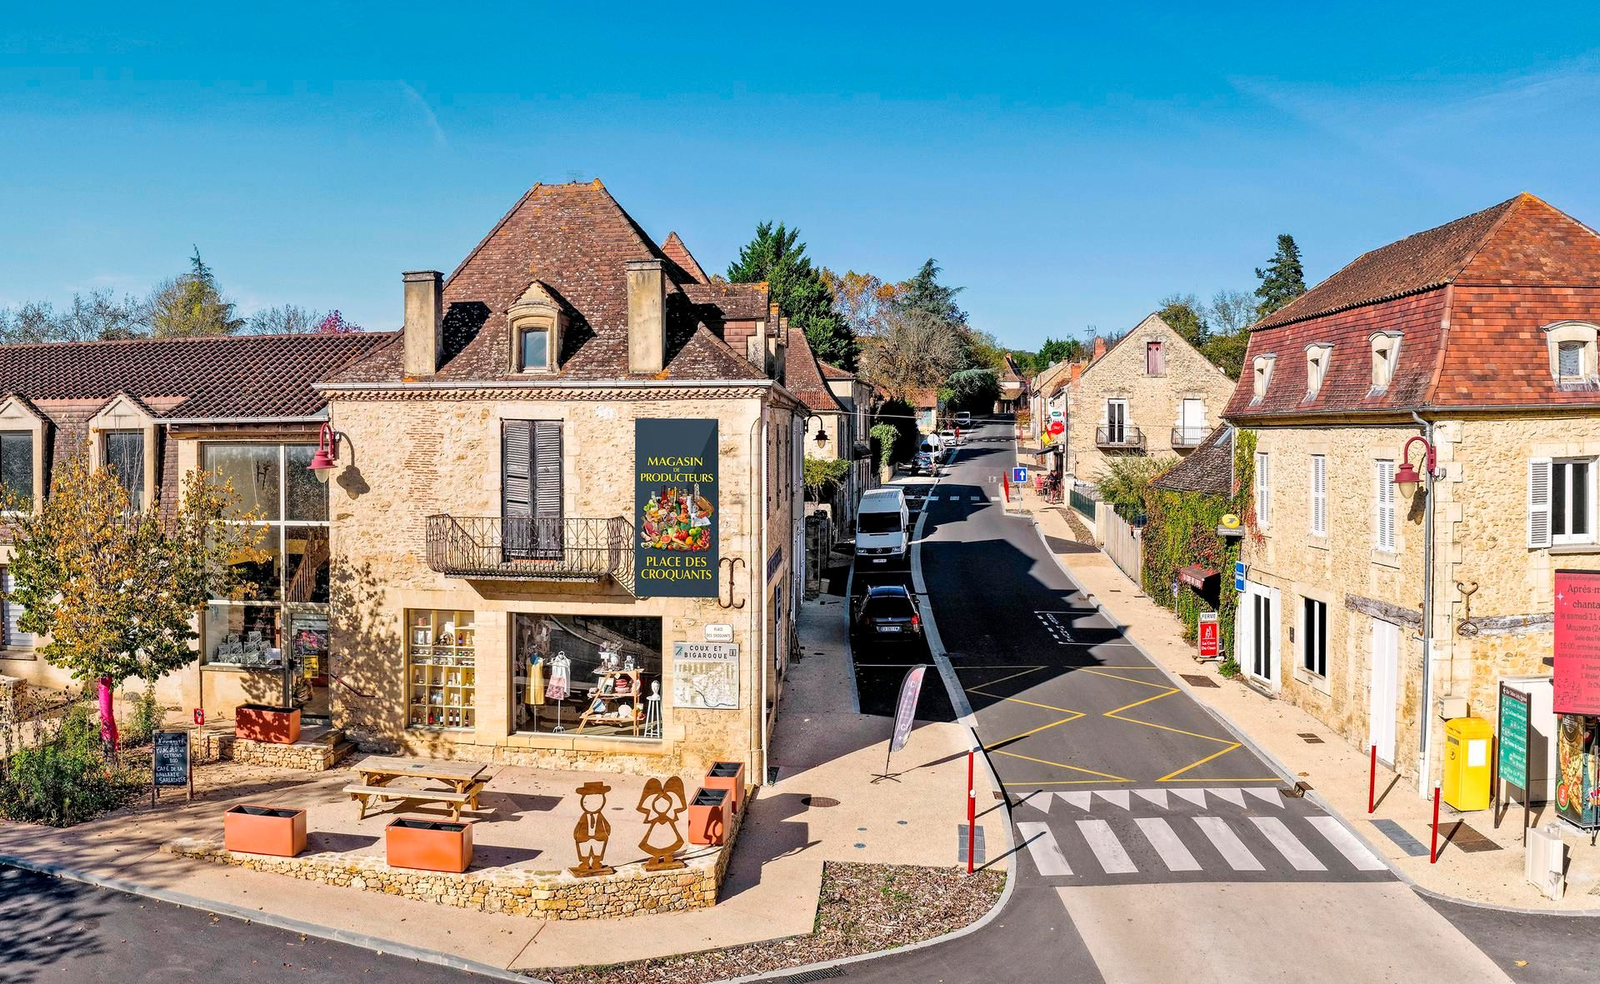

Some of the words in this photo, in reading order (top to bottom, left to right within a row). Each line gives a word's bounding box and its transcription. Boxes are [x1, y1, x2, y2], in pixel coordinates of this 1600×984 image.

[647, 456, 703, 466] MAGASIN
[640, 473, 714, 482] PRODUCTEURS
[646, 556, 681, 567] PLACE
[685, 556, 707, 567] DES
[641, 569, 713, 581] CROQUANTS
